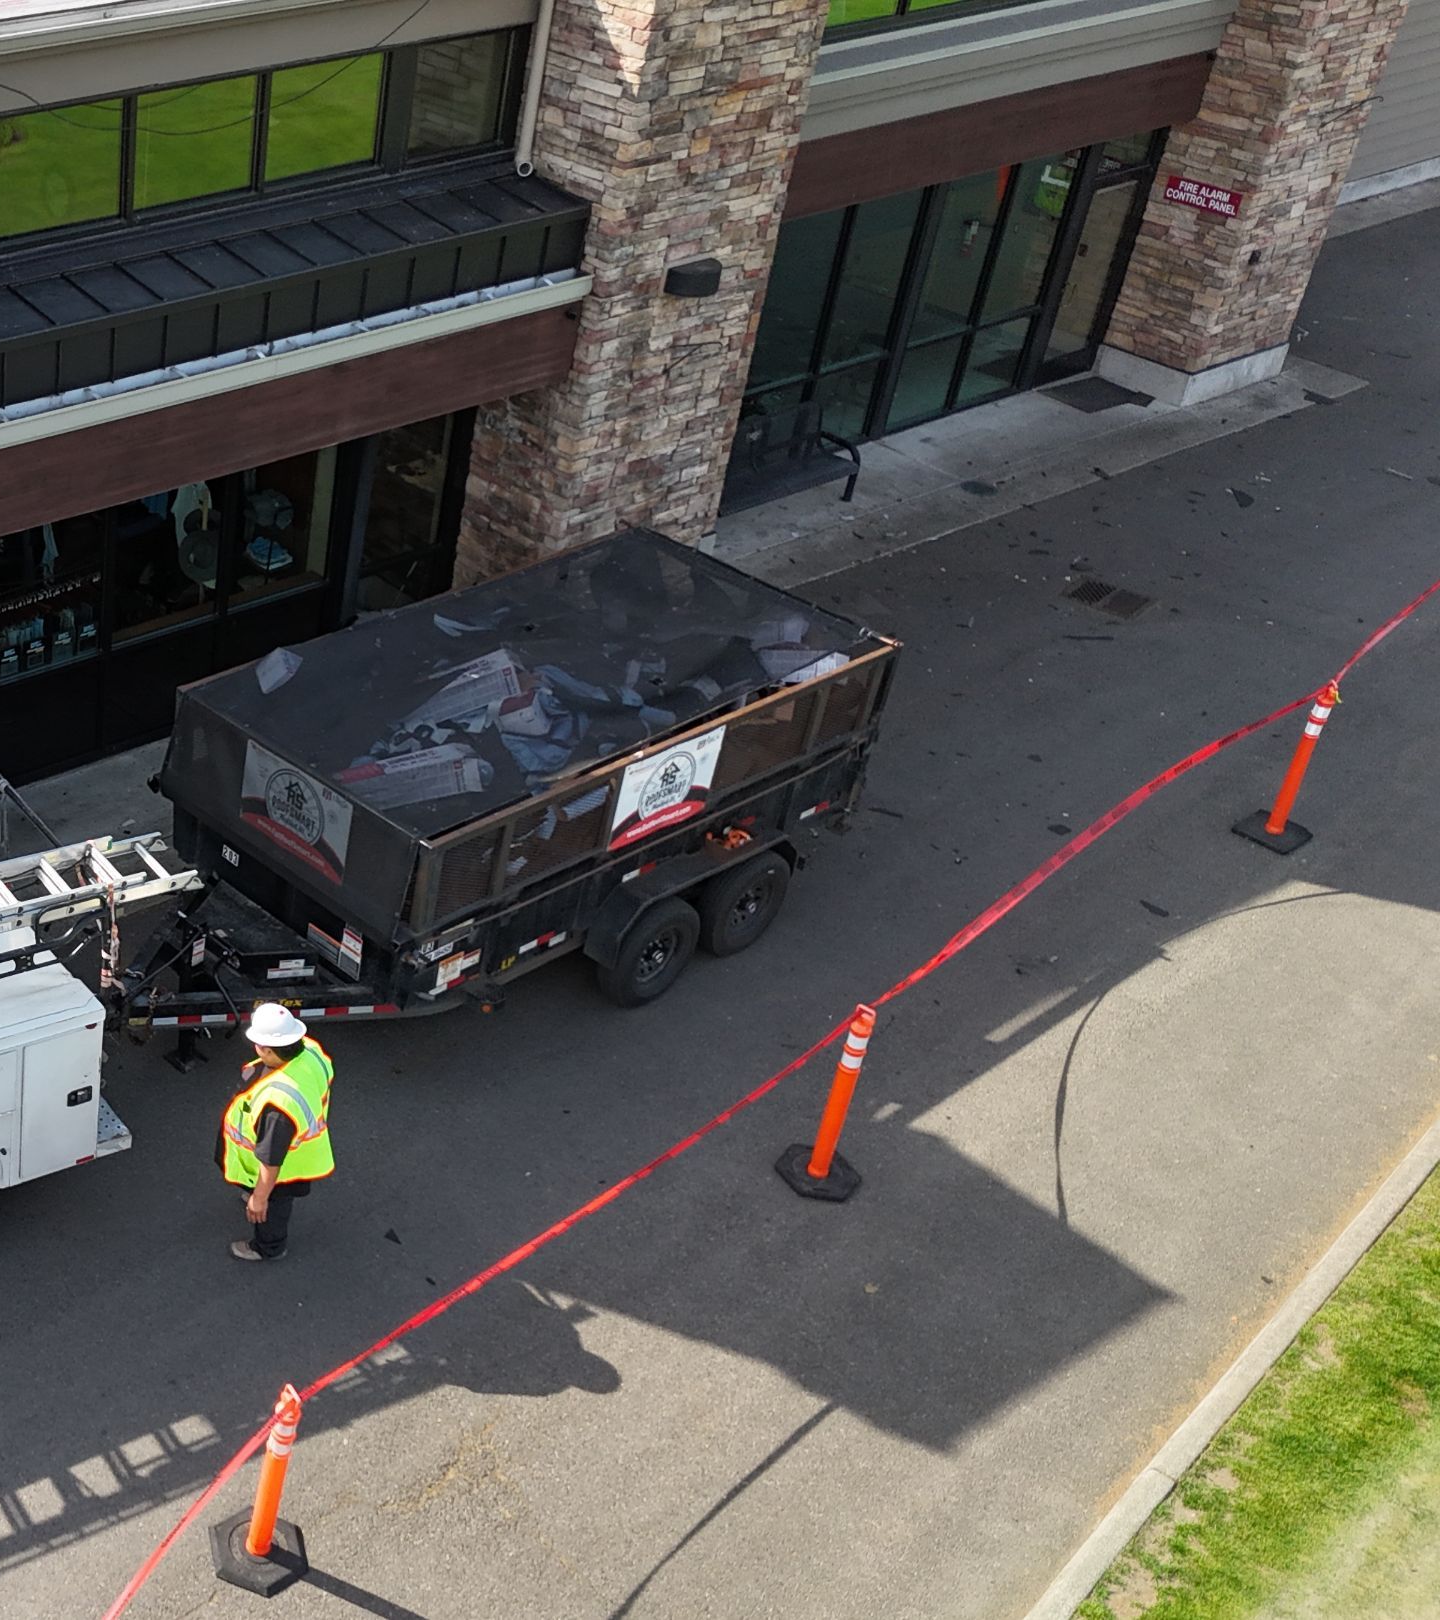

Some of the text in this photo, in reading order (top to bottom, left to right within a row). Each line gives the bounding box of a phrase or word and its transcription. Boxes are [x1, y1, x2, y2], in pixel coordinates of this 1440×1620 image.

[1166, 188, 1236, 215] CONTROL PANEL
[1179, 181, 1231, 202] FIRE ALARM
[223, 847, 238, 865] 203
